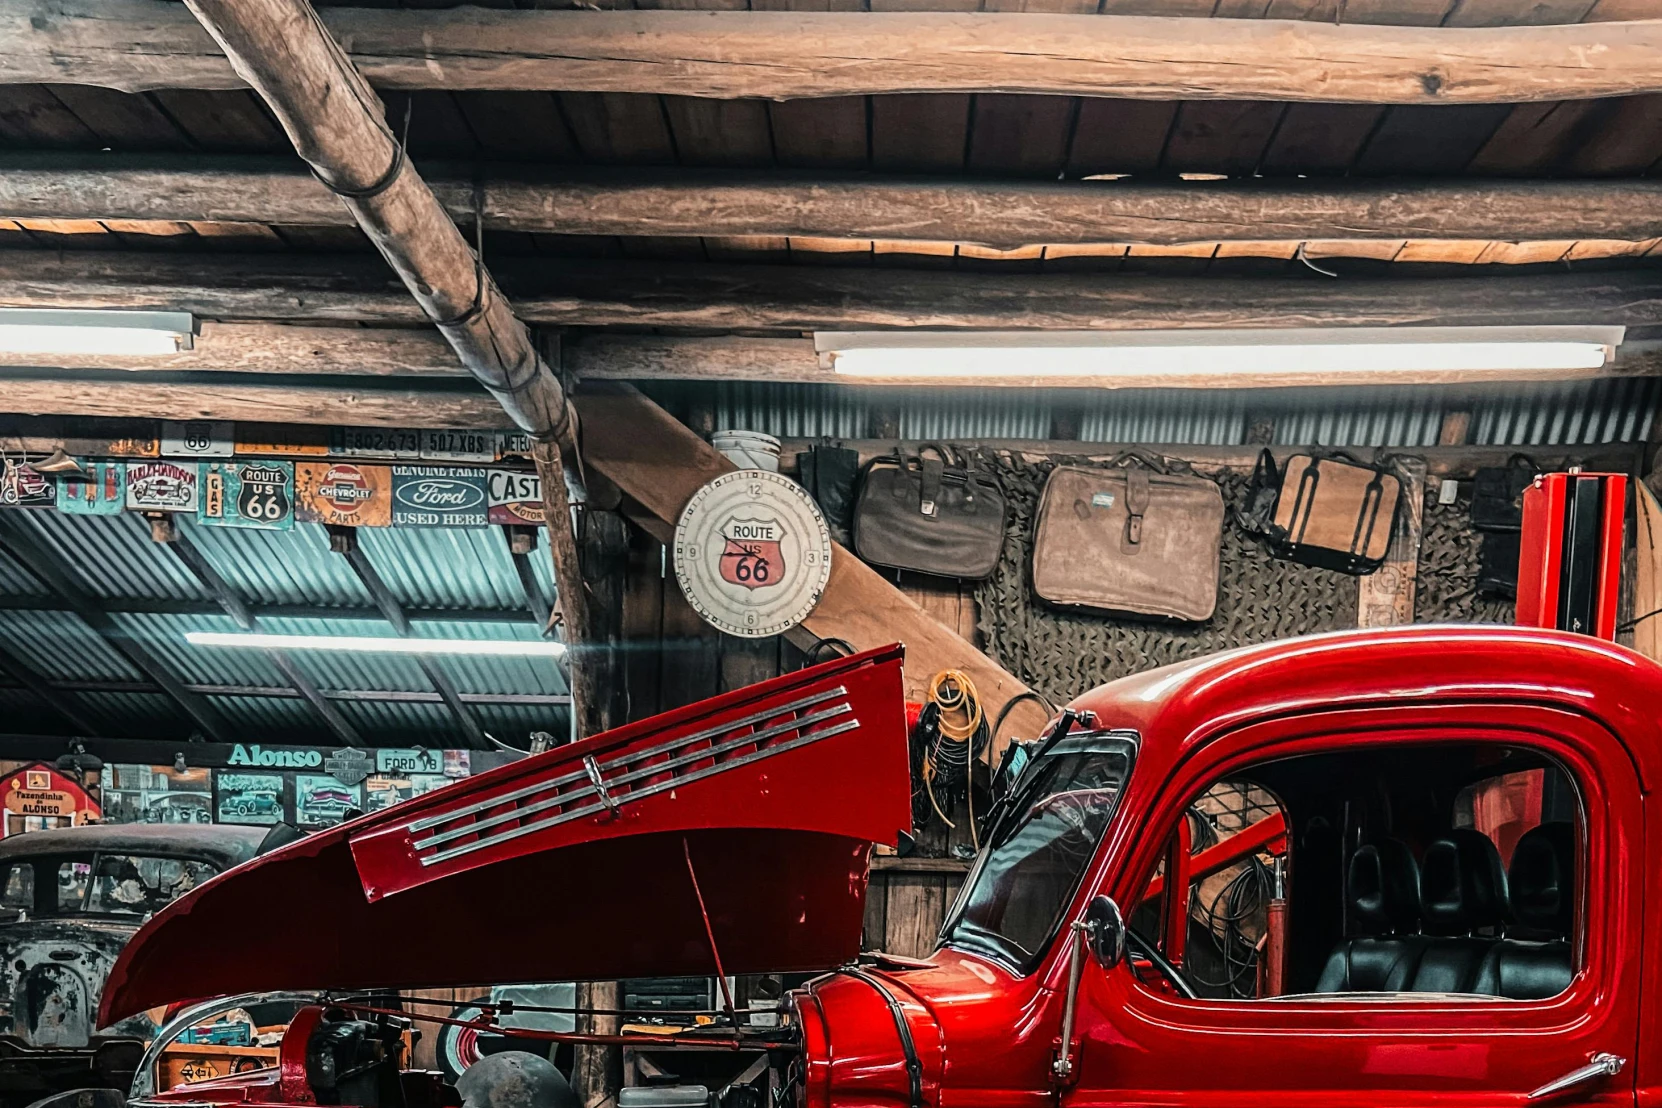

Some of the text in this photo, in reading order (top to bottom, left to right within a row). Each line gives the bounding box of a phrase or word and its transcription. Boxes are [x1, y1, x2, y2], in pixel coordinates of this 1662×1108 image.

[187, 435, 207, 448] 66
[430, 434, 484, 453] 507 XBS
[246, 470, 281, 482] ROUTE
[392, 466, 486, 477] GENUINE PARTS
[253, 484, 275, 495] US
[319, 487, 370, 498] CHEVROLET
[413, 482, 467, 504] Ford
[749, 484, 761, 495] 12
[246, 495, 281, 519] 66
[513, 505, 543, 520] MOTOR
[329, 510, 361, 523] PARTS
[396, 512, 439, 524] USED
[733, 525, 773, 539] ROUTE
[689, 547, 696, 557] 9
[808, 553, 815, 562] 3
[736, 558, 769, 582] 66
[748, 614, 754, 624] 6
[227, 744, 322, 767] Alonso
[385, 758, 415, 770] FORD
[22, 804, 60, 814] ALONSO
